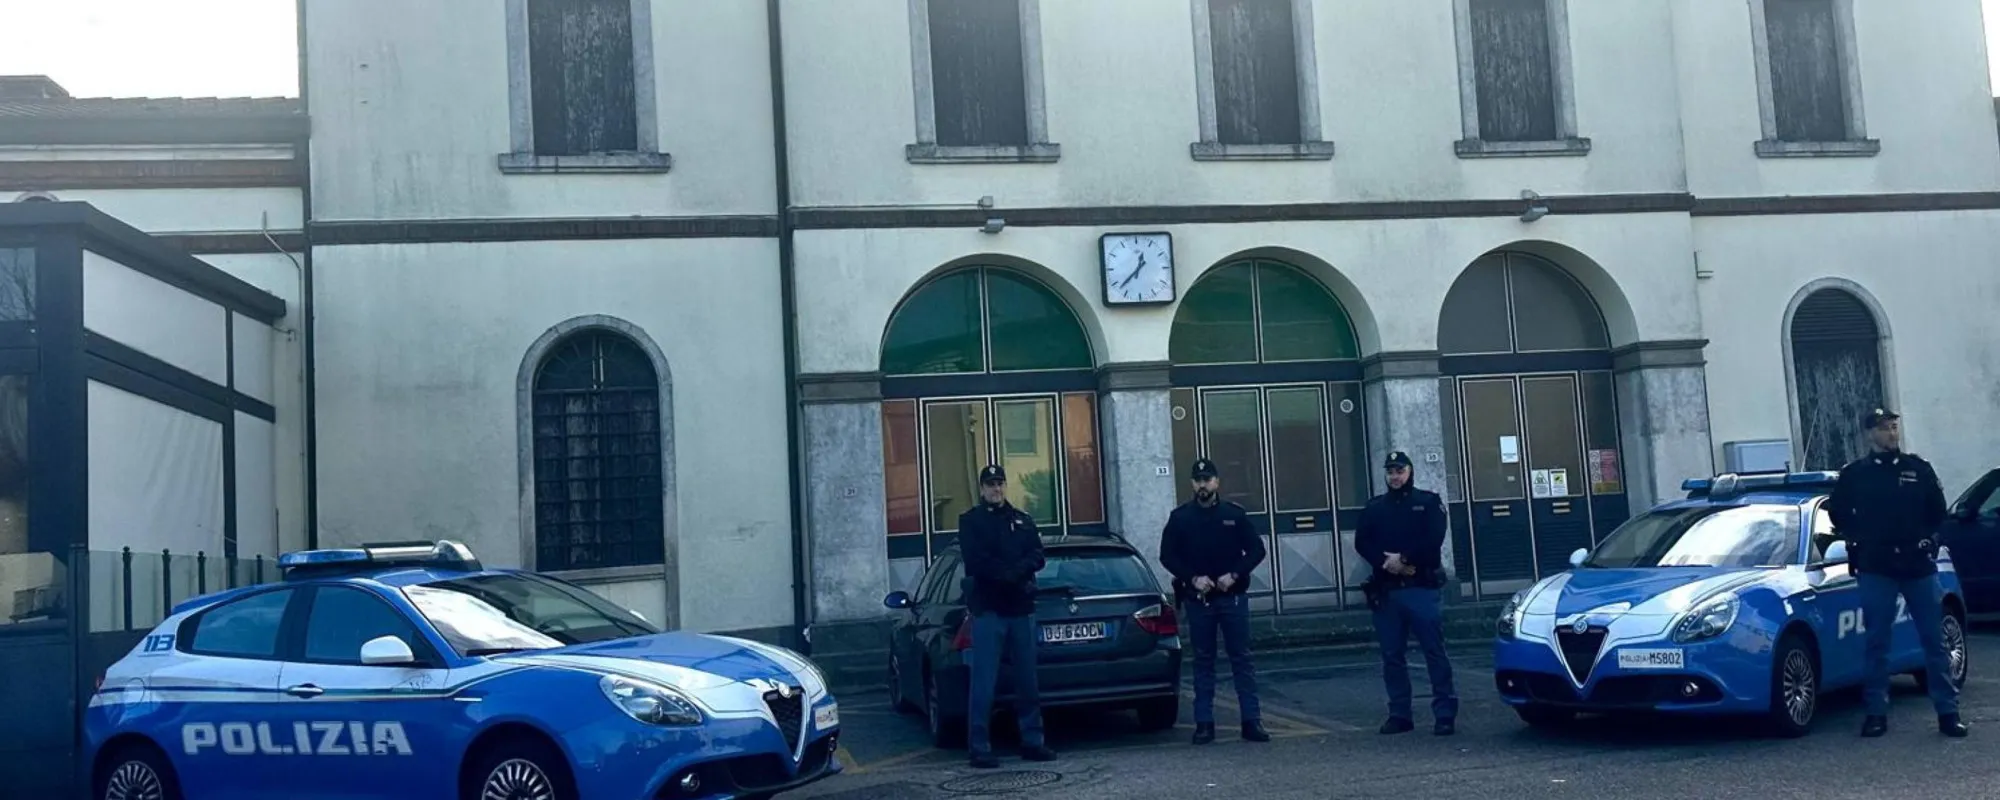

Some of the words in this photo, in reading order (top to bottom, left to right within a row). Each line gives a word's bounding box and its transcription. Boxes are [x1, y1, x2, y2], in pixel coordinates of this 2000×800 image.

[143, 634, 176, 652] 113
[1649, 652, 1681, 664] M5802
[181, 720, 413, 755] POLIZIA
